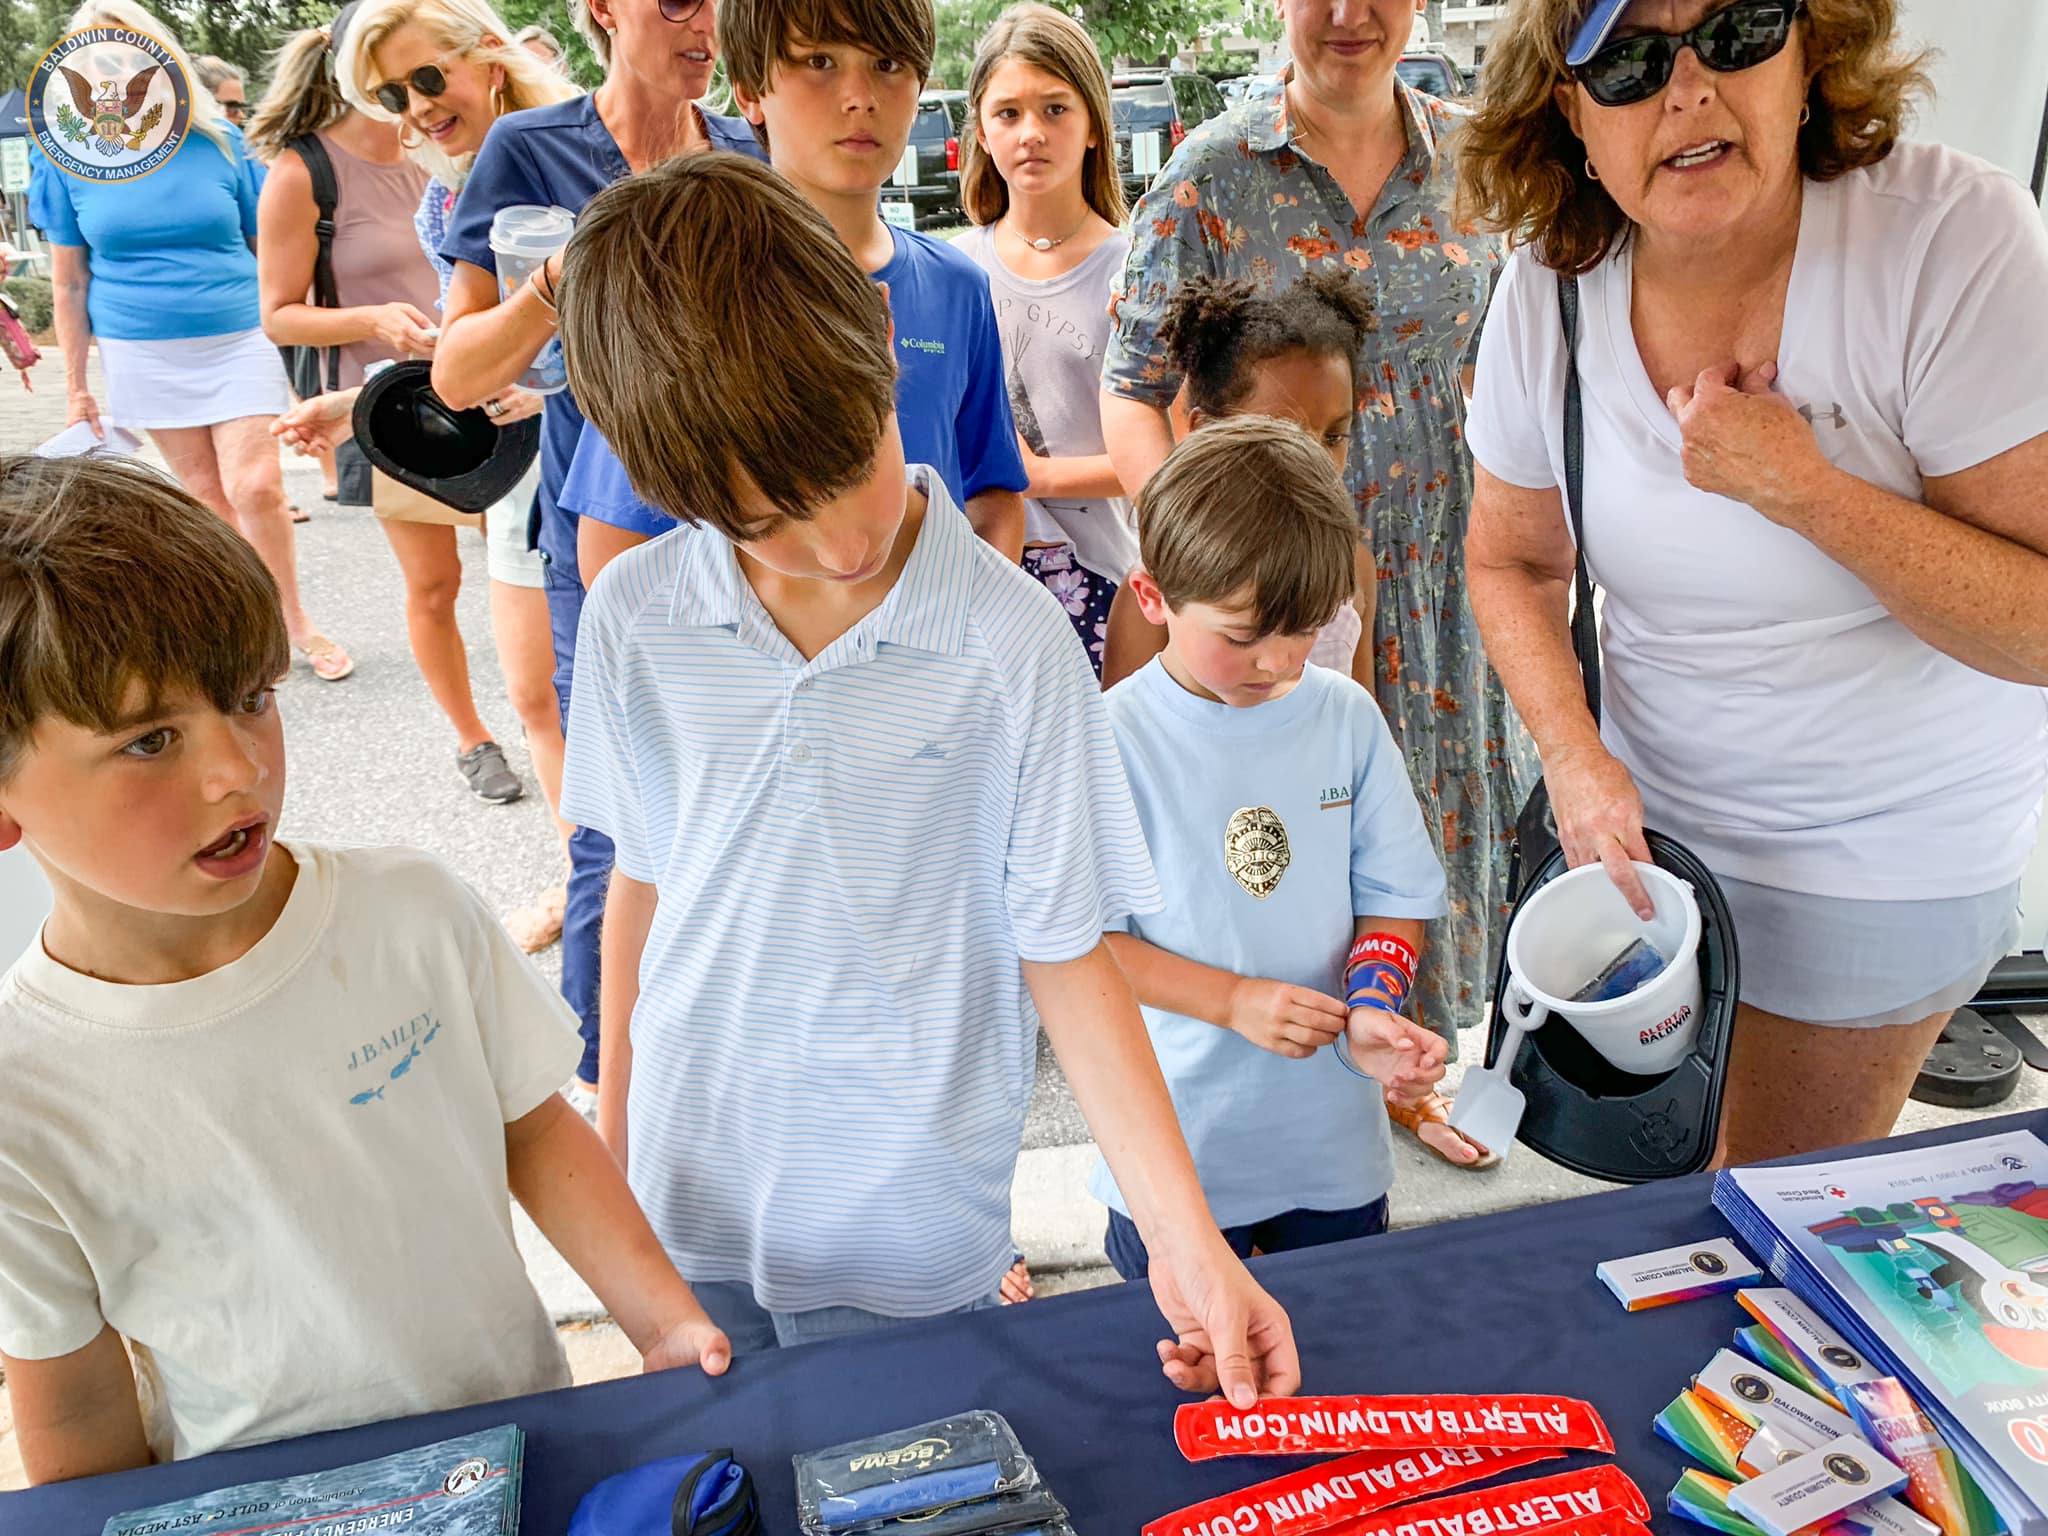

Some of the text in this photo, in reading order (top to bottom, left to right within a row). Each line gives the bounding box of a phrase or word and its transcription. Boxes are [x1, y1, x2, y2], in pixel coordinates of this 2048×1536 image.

[1027, 303, 1100, 360] GYPSY
[1320, 784, 1352, 802] J.BA
[1640, 1011, 1680, 1039] ALERT
[1640, 1008, 1691, 1045] BALDWIN
[1634, 1272, 1663, 1283] COUNTY
[1662, 1266, 1695, 1278] BALDWIN
[1215, 1409, 1568, 1440] ALERTBALDWIN.COM
[1774, 1397, 1814, 1423] BALDWIN
[1814, 1420, 1840, 1438] COUN
[850, 1445, 934, 1472] BCEMA
[290, 1488, 355, 1506] publication
[1182, 1446, 1520, 1536] ERTBALDWIN.CO
[1803, 1476, 1837, 1493] BALDWIN
[227, 1502, 270, 1518] GULF
[1865, 1505, 1905, 1533] COUNTY
